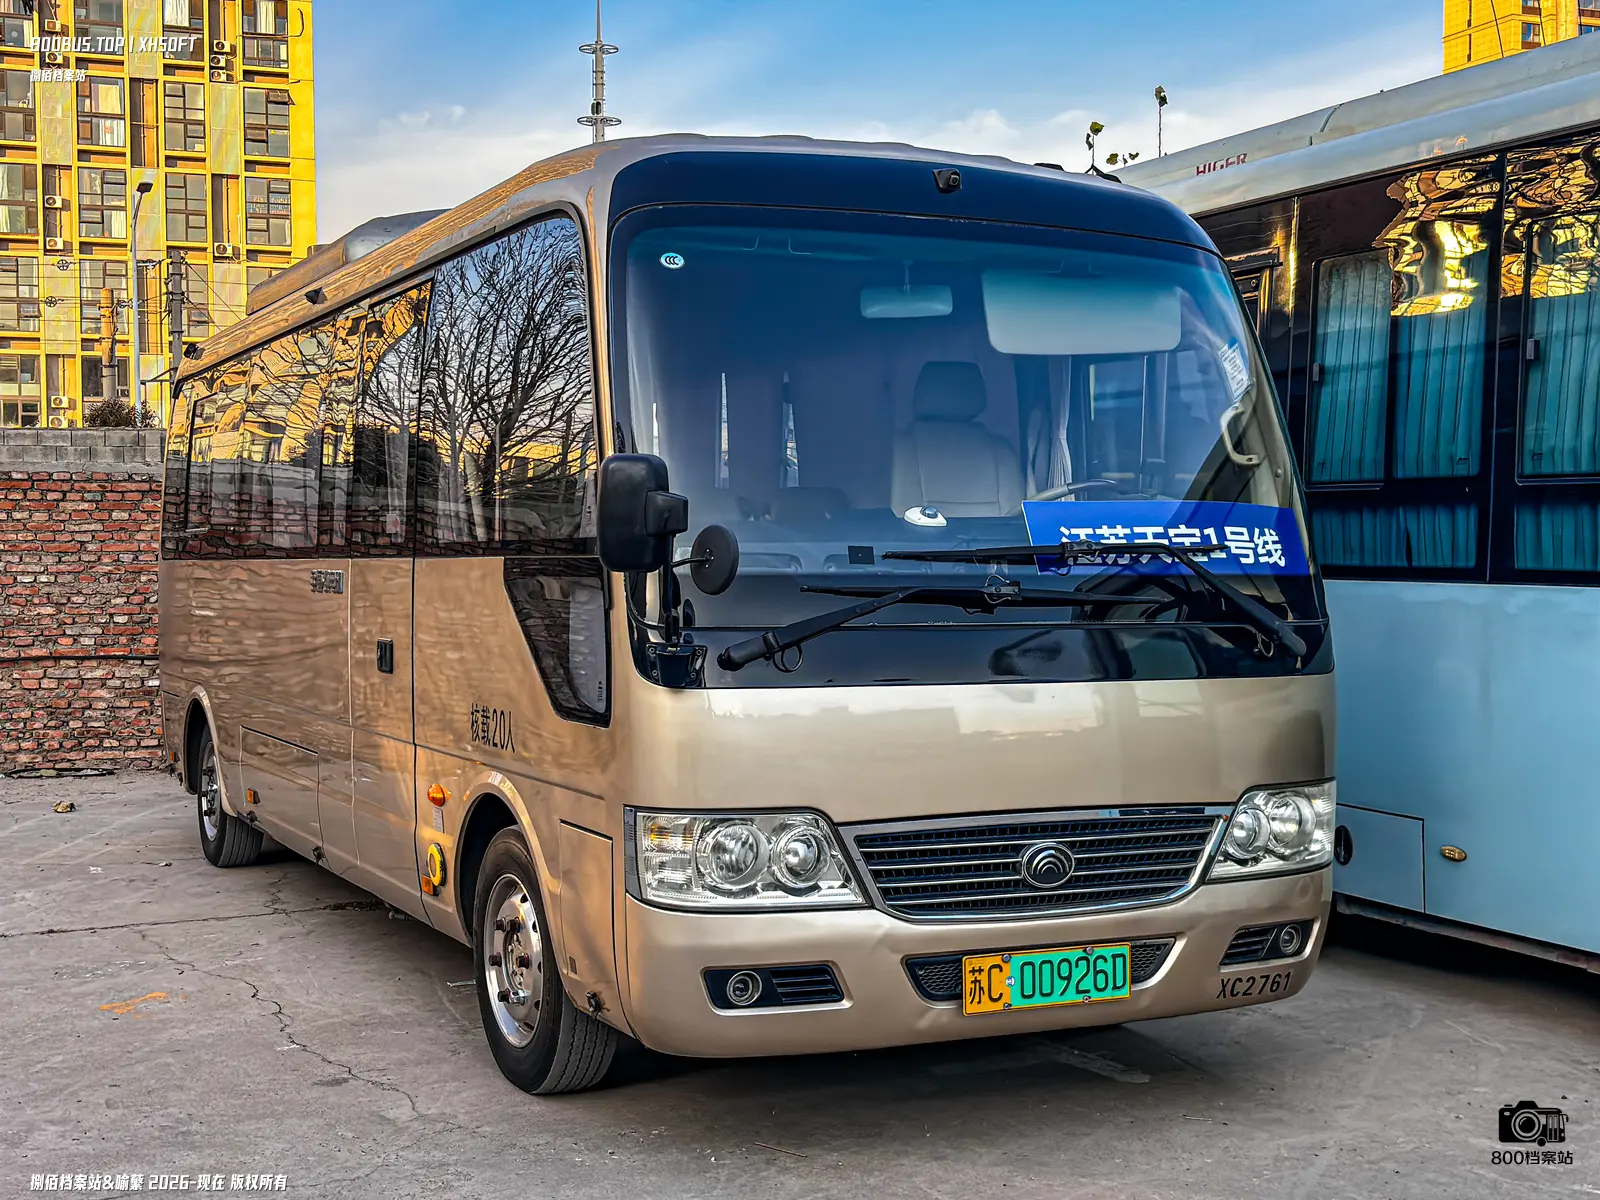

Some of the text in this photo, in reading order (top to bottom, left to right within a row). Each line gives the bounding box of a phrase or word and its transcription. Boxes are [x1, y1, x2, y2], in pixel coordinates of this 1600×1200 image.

[470, 702, 516, 754] 核载20人
[1020, 952, 1127, 1000] 00926D
[1216, 971, 1292, 999] XC2761
